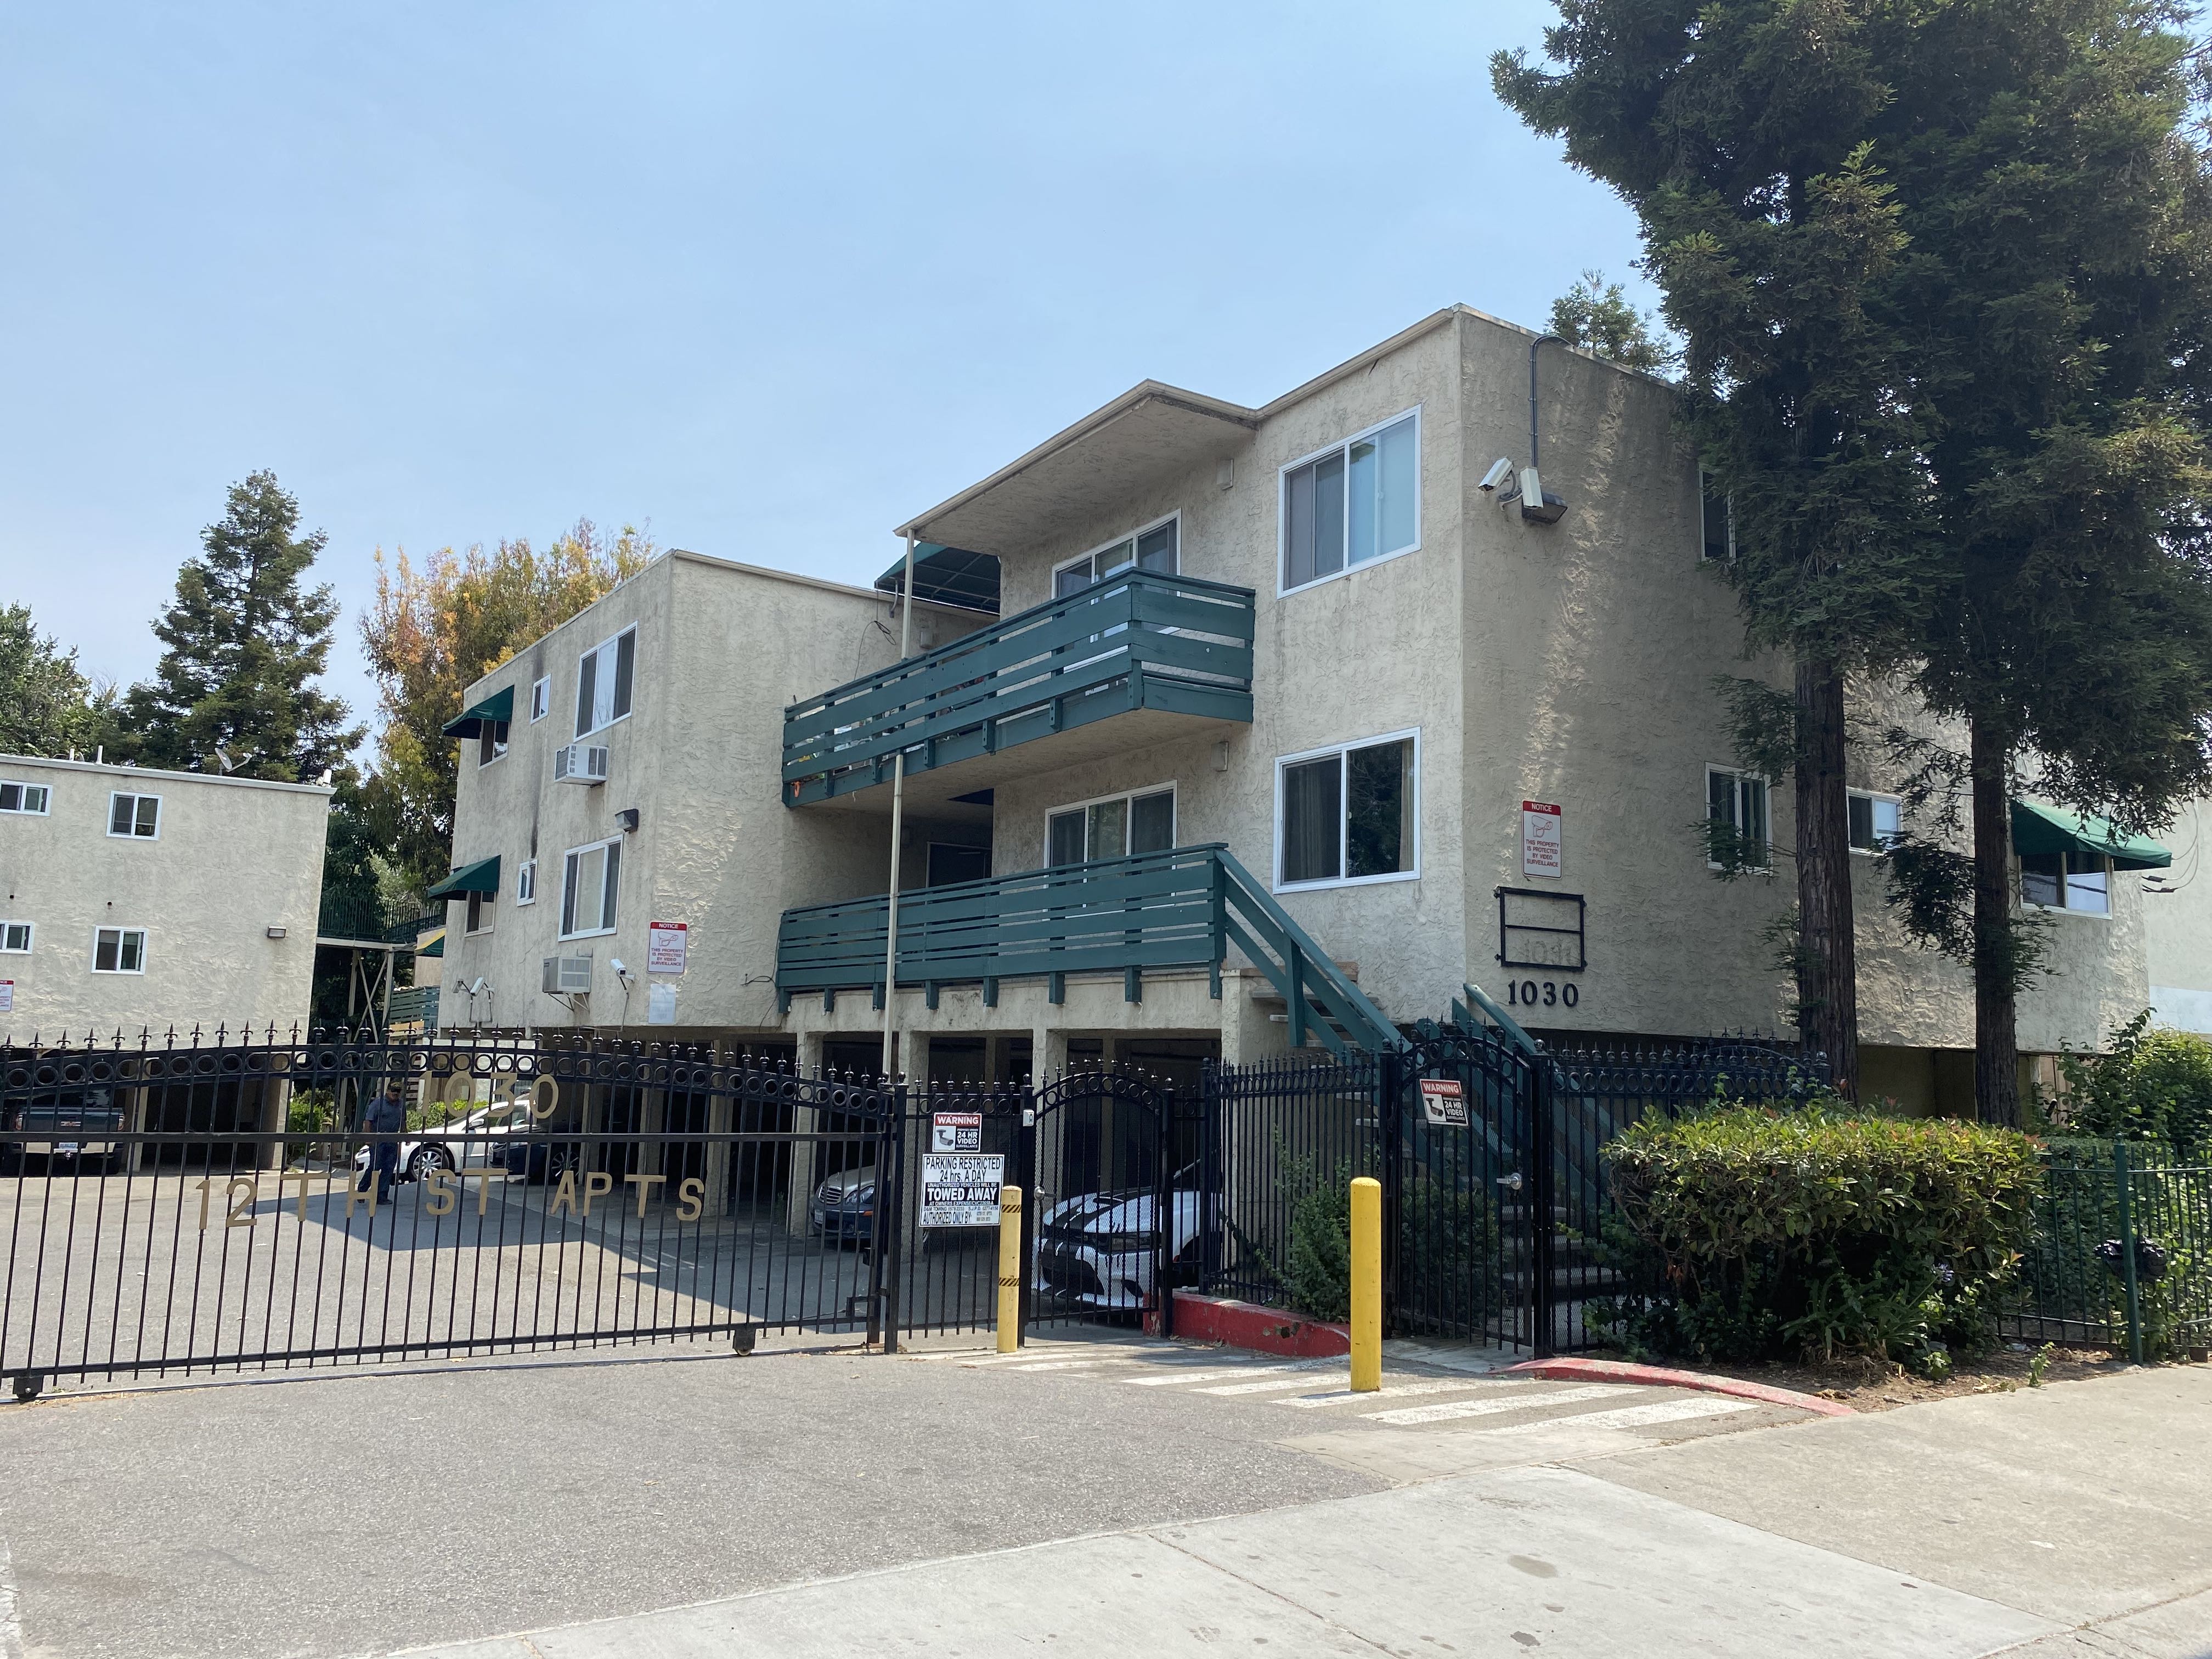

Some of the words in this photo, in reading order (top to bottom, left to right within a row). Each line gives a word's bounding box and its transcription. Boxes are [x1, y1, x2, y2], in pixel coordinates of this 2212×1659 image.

[1532, 803, 1552, 812] NOTICE
[1527, 859, 1558, 867] SURVEILLANCE
[1508, 979, 1578, 1007] 1030
[1423, 1082, 1459, 1093] WARNING
[418, 1070, 560, 1119] 1030
[1453, 1101, 1463, 1109] HR
[1446, 1108, 1463, 1116] VIDEO
[937, 1116, 979, 1124] WARNING
[926, 1157, 957, 1170] PARKING
[959, 1157, 1001, 1170] RESTRICTED
[940, 1170, 948, 1182] 24
[950, 1169, 963, 1182] hrs.
[964, 1169, 969, 1182] A
[972, 1169, 986, 1182] DAY
[195, 1170, 381, 1229] 12TH
[426, 1168, 509, 1216] ST
[549, 1170, 705, 1221] APTS
[927, 1188, 964, 1201] TOWED
[967, 1187, 997, 1200] AWAY
[923, 1211, 952, 1224] AUTHORIZED
[953, 1211, 964, 1224] ONLY
